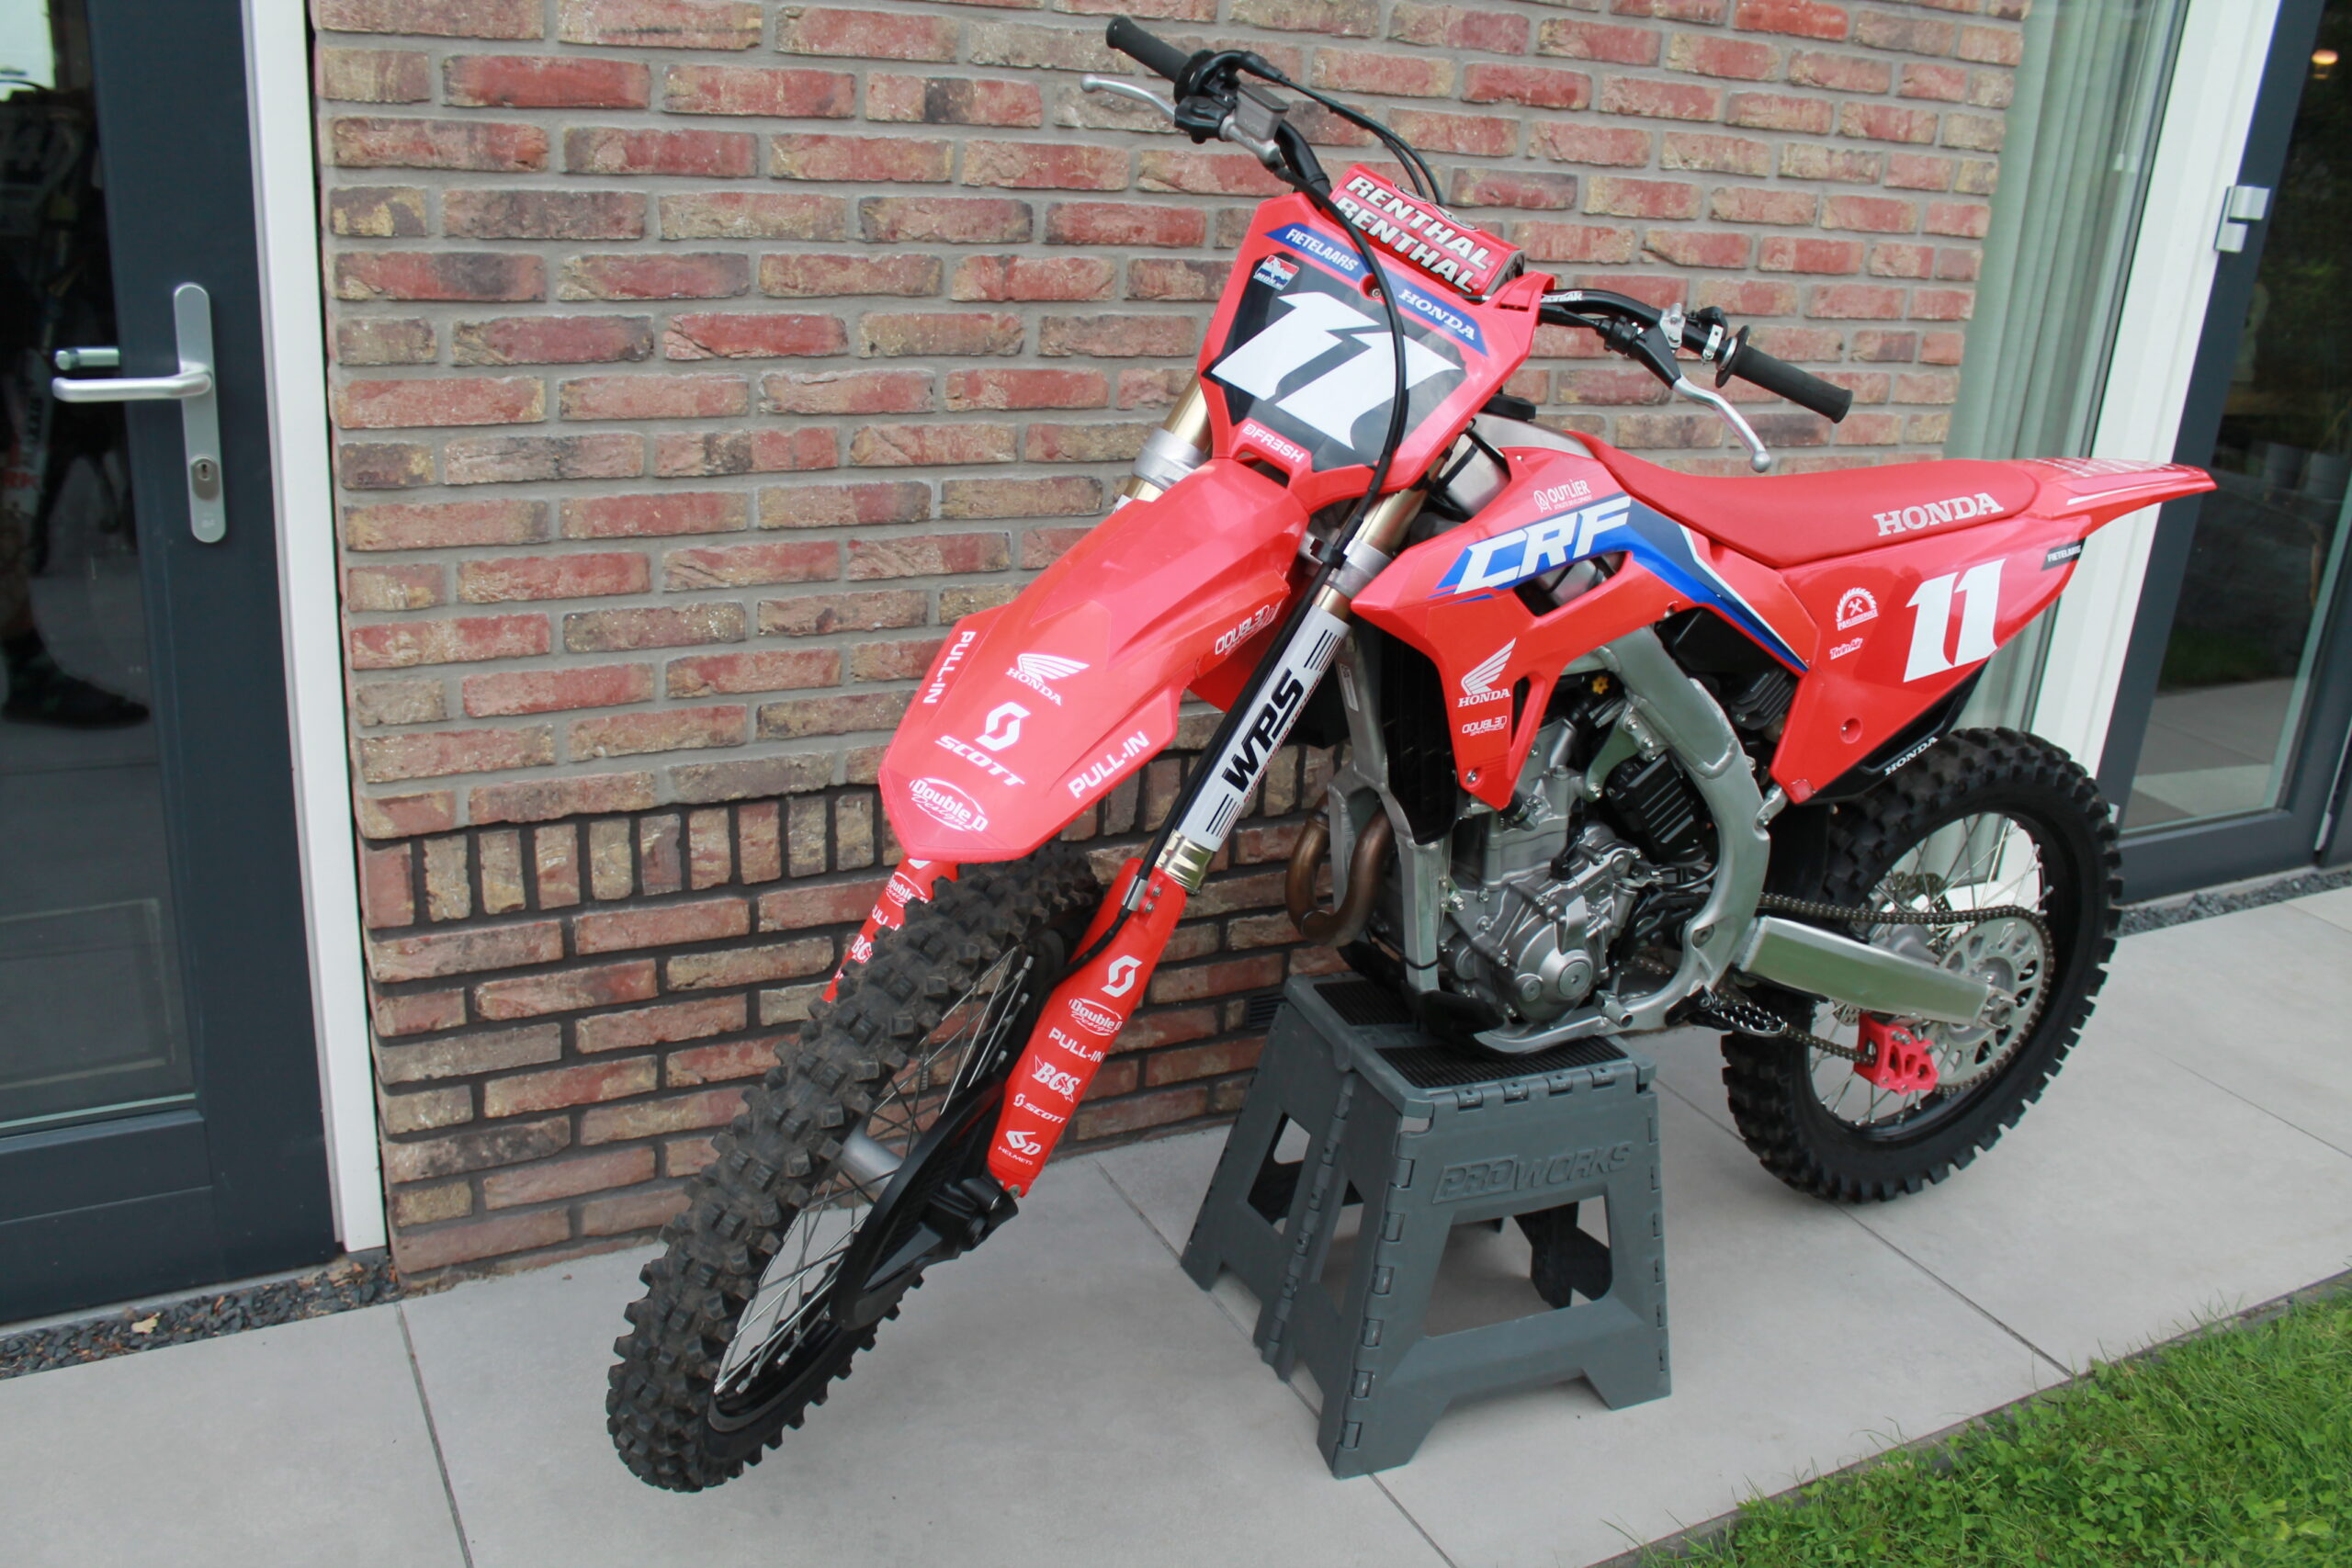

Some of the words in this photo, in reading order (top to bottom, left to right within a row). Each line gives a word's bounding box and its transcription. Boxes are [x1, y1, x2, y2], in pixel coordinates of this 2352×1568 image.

[1334, 197, 1475, 293] RENTHAL
[1345, 175, 1490, 270] RENTHAL
[1285, 228, 1359, 272] FIETELAARS
[1398, 288, 1476, 341] HONDA
[1210, 290, 1462, 451] 11
[1872, 492, 2004, 536] HONDA
[1453, 496, 1632, 594] CRF
[1903, 558, 2007, 683] 11
[922, 630, 976, 705] PULL-IN
[1006, 667, 1063, 705] HONDA
[1457, 688, 1510, 708] HONDA
[1221, 667, 1305, 793] WPS
[1884, 736, 1939, 776] HONDA
[934, 735, 1026, 788] SCOTT
[1068, 731, 1151, 798] PULL-IN
[911, 779, 972, 822] Double
[972, 814, 989, 832] D
[1070, 998, 1115, 1030] Double
[1048, 1027, 1104, 1063] PULL-IN
[1032, 1062, 1081, 1095] BCS
[1023, 1102, 1066, 1123] SCOTT
[998, 1145, 1034, 1166] HELMETS
